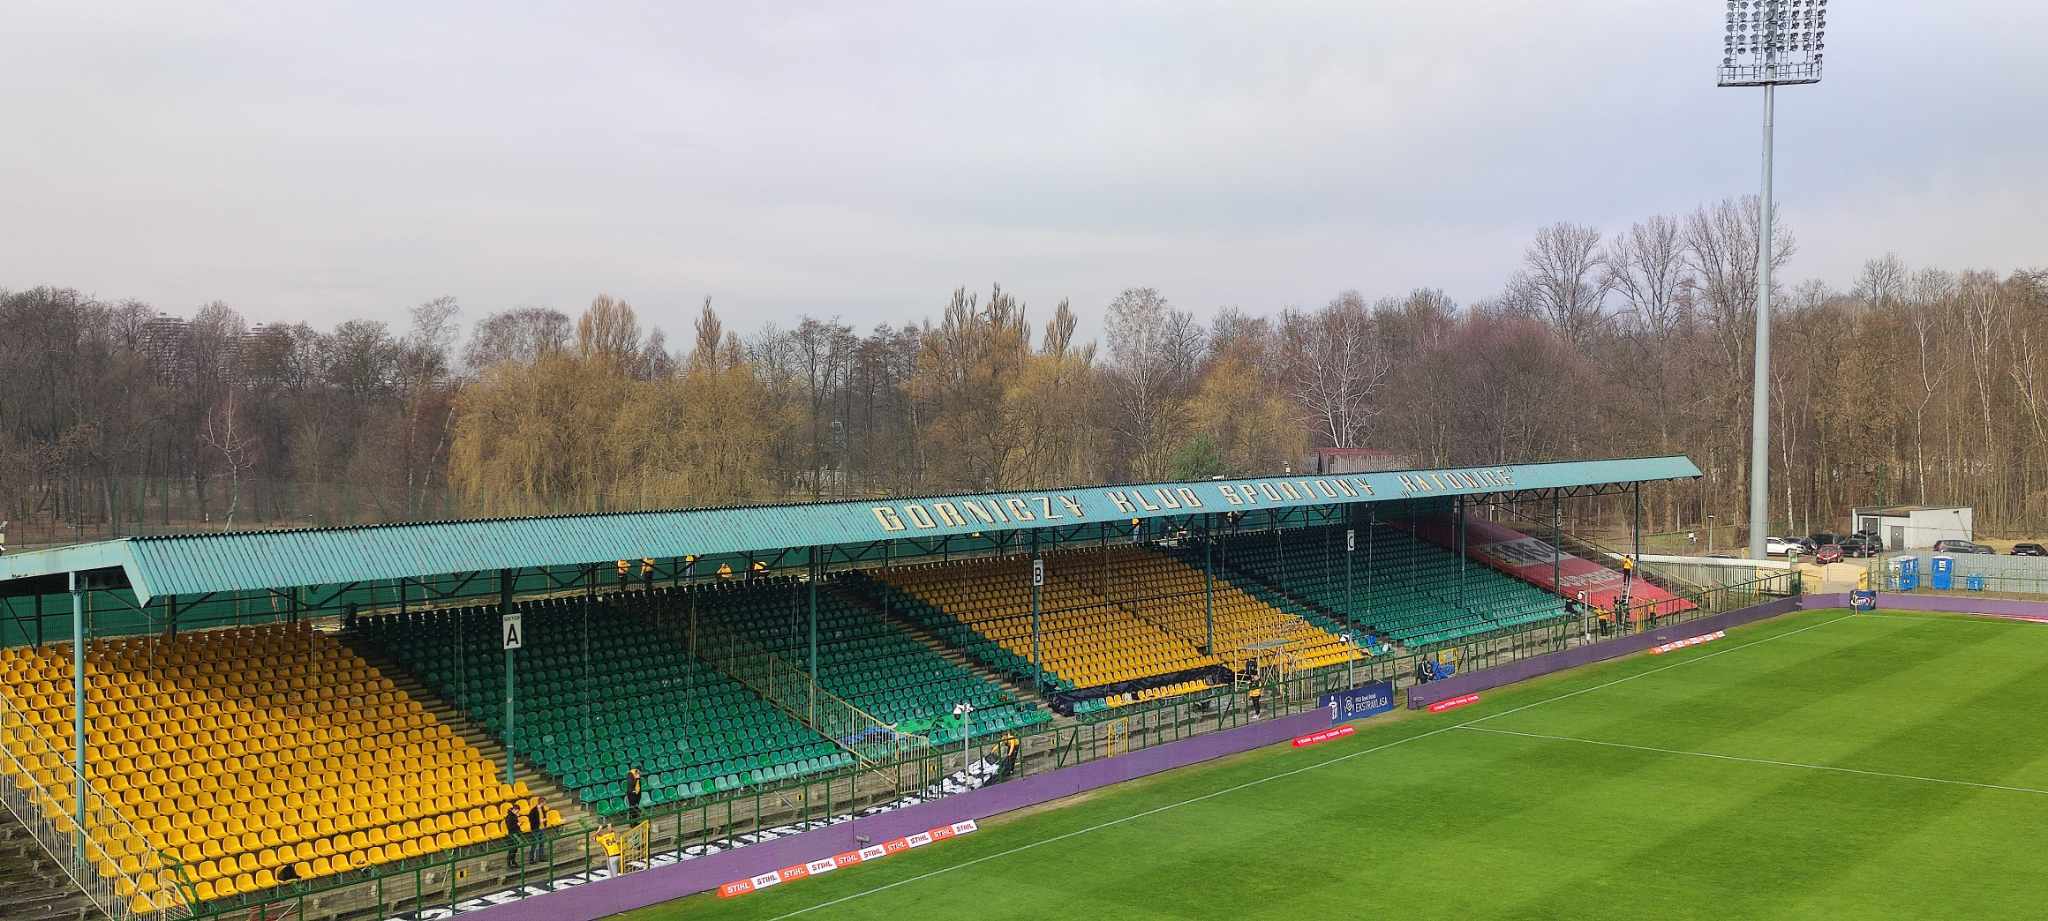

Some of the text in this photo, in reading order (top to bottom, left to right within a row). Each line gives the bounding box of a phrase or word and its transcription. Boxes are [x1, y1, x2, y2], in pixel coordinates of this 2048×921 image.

[1104, 487, 1203, 513] KLUB
[1219, 478, 1375, 505] SPORTOWY
[1035, 567, 1042, 582] B
[506, 623, 519, 646] A
[727, 882, 750, 894] STIHL
[757, 876, 777, 886] STIHL
[784, 868, 805, 878] STIHL
[811, 861, 833, 872] STIHL
[838, 854, 858, 864] STIHL
[863, 849, 883, 858] STIHL
[910, 834, 929, 844] STIHL
